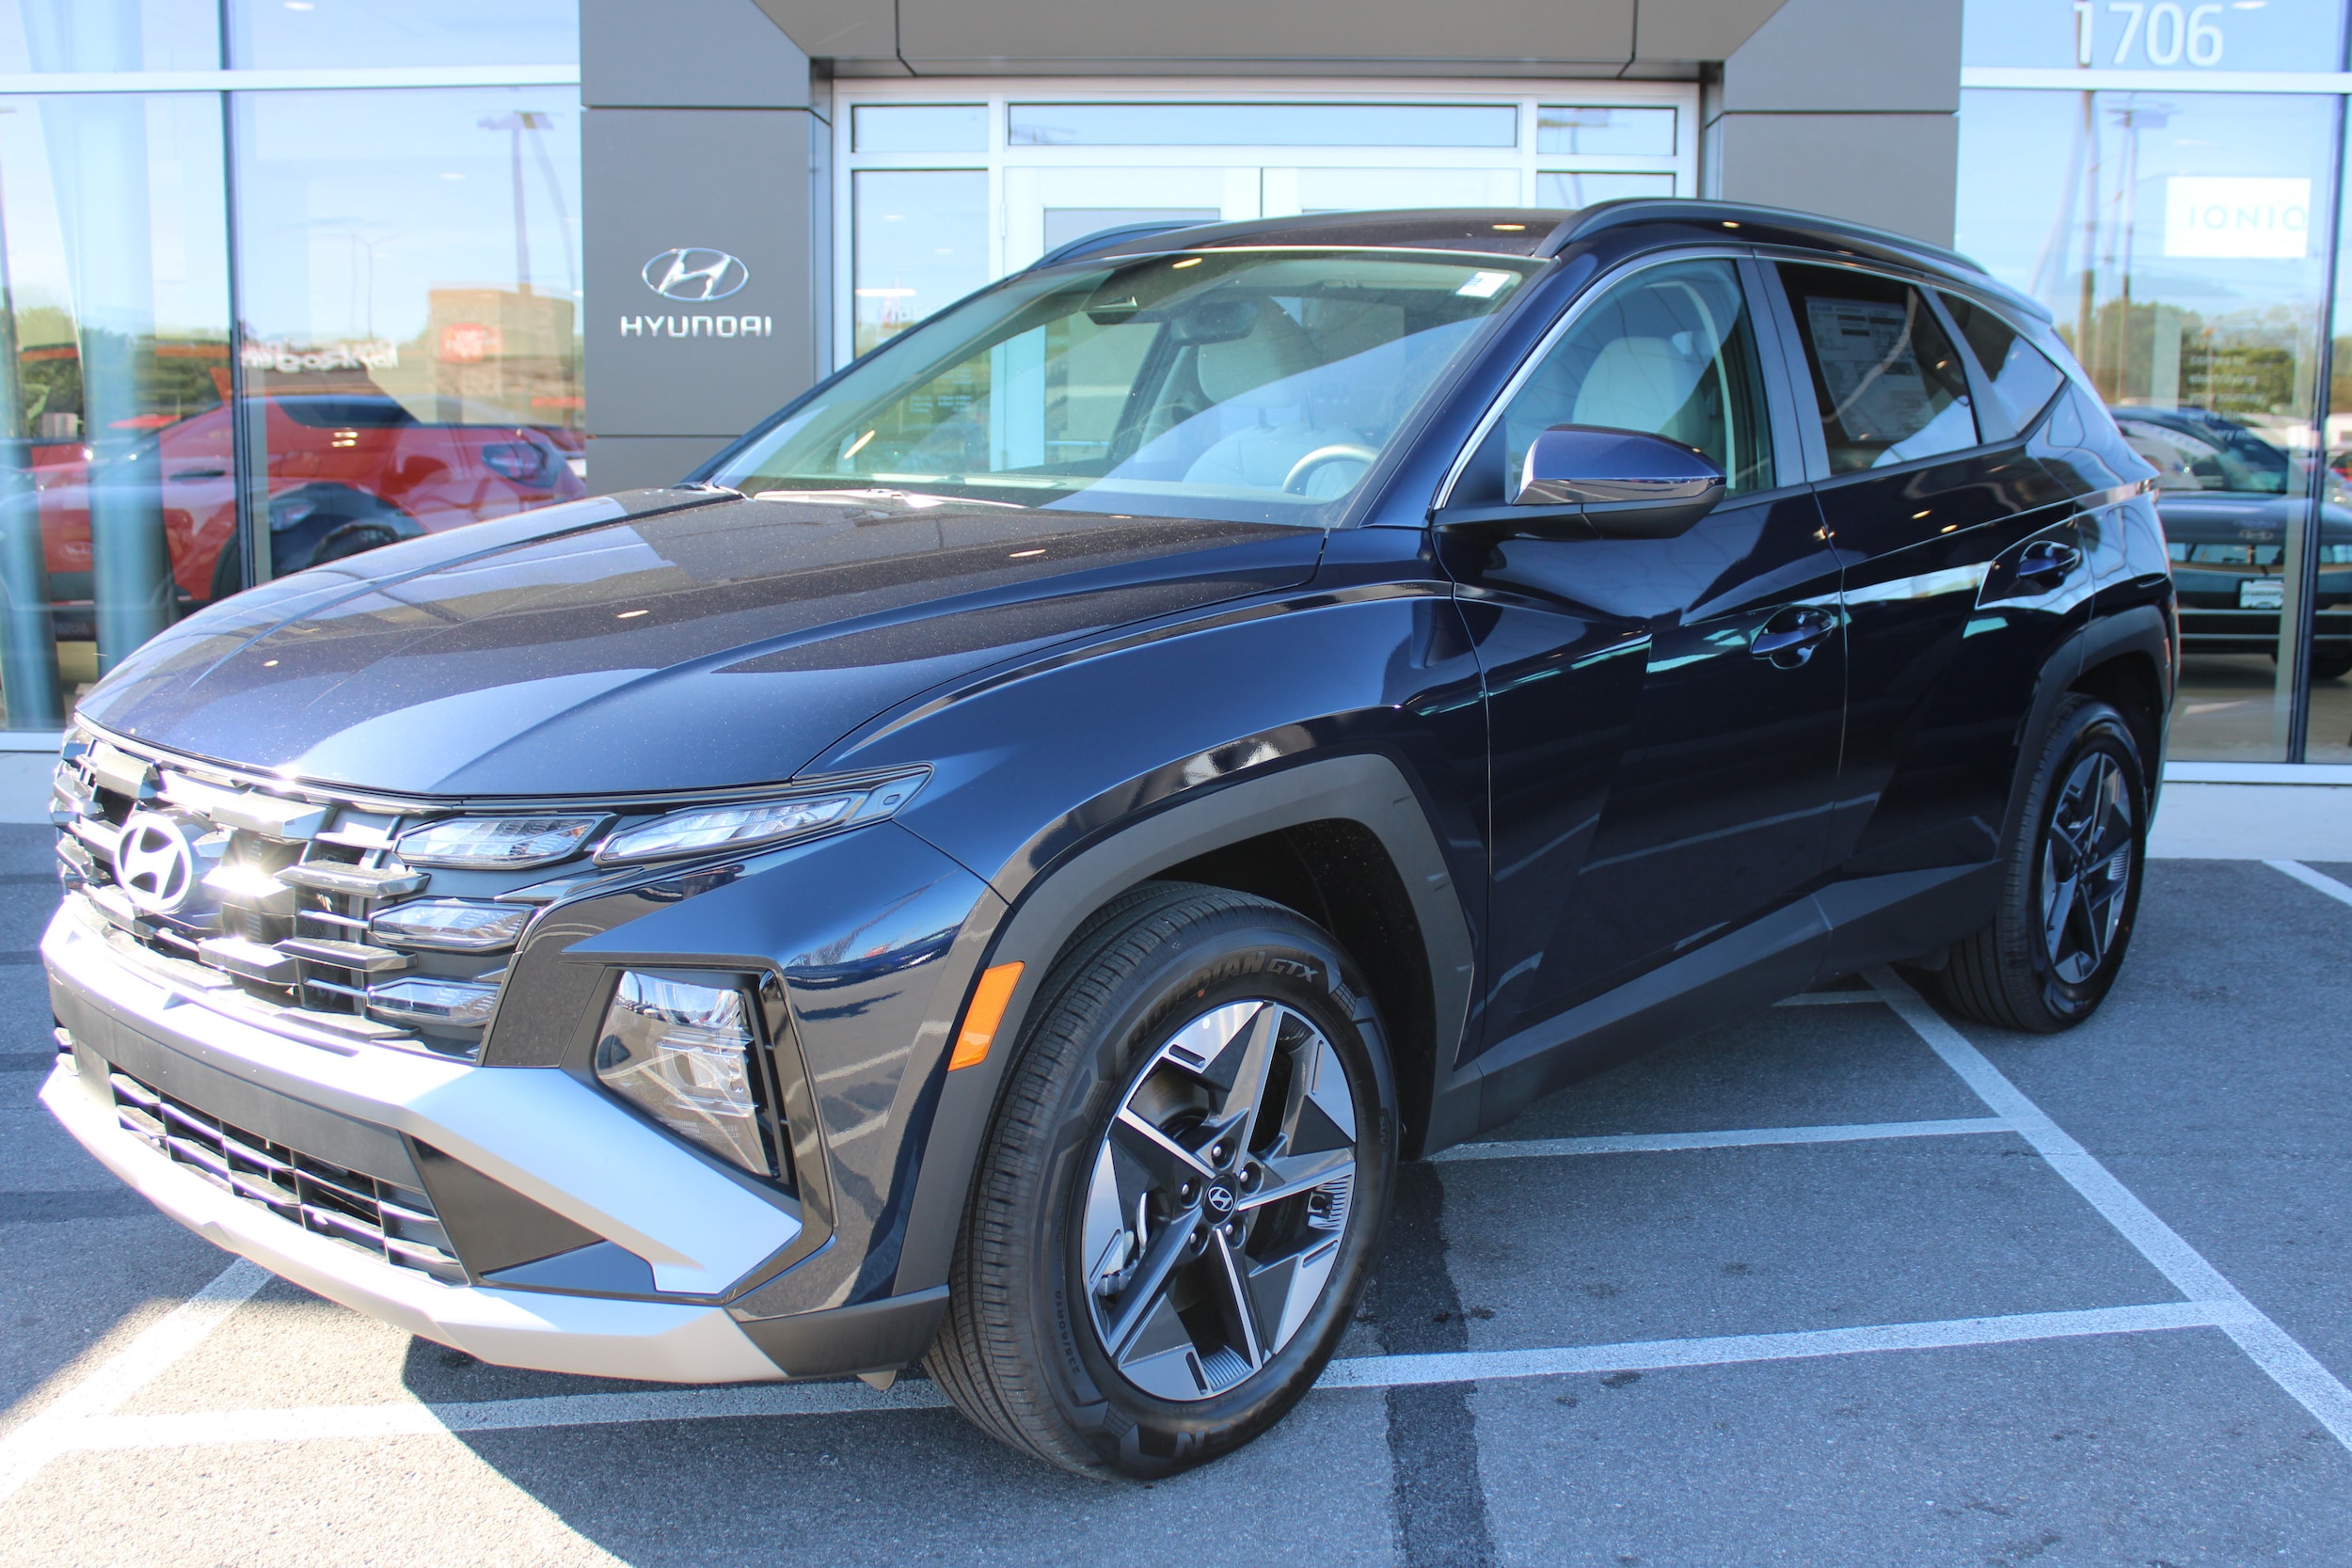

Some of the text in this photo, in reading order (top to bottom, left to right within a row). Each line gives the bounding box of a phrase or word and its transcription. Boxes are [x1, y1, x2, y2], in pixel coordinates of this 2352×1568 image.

[2073, 2, 2224, 67] 1706
[620, 315, 772, 338] HYUNDAI
[1266, 958, 1319, 983] GTX
[1055, 1290, 1080, 1375] 235/60R18
